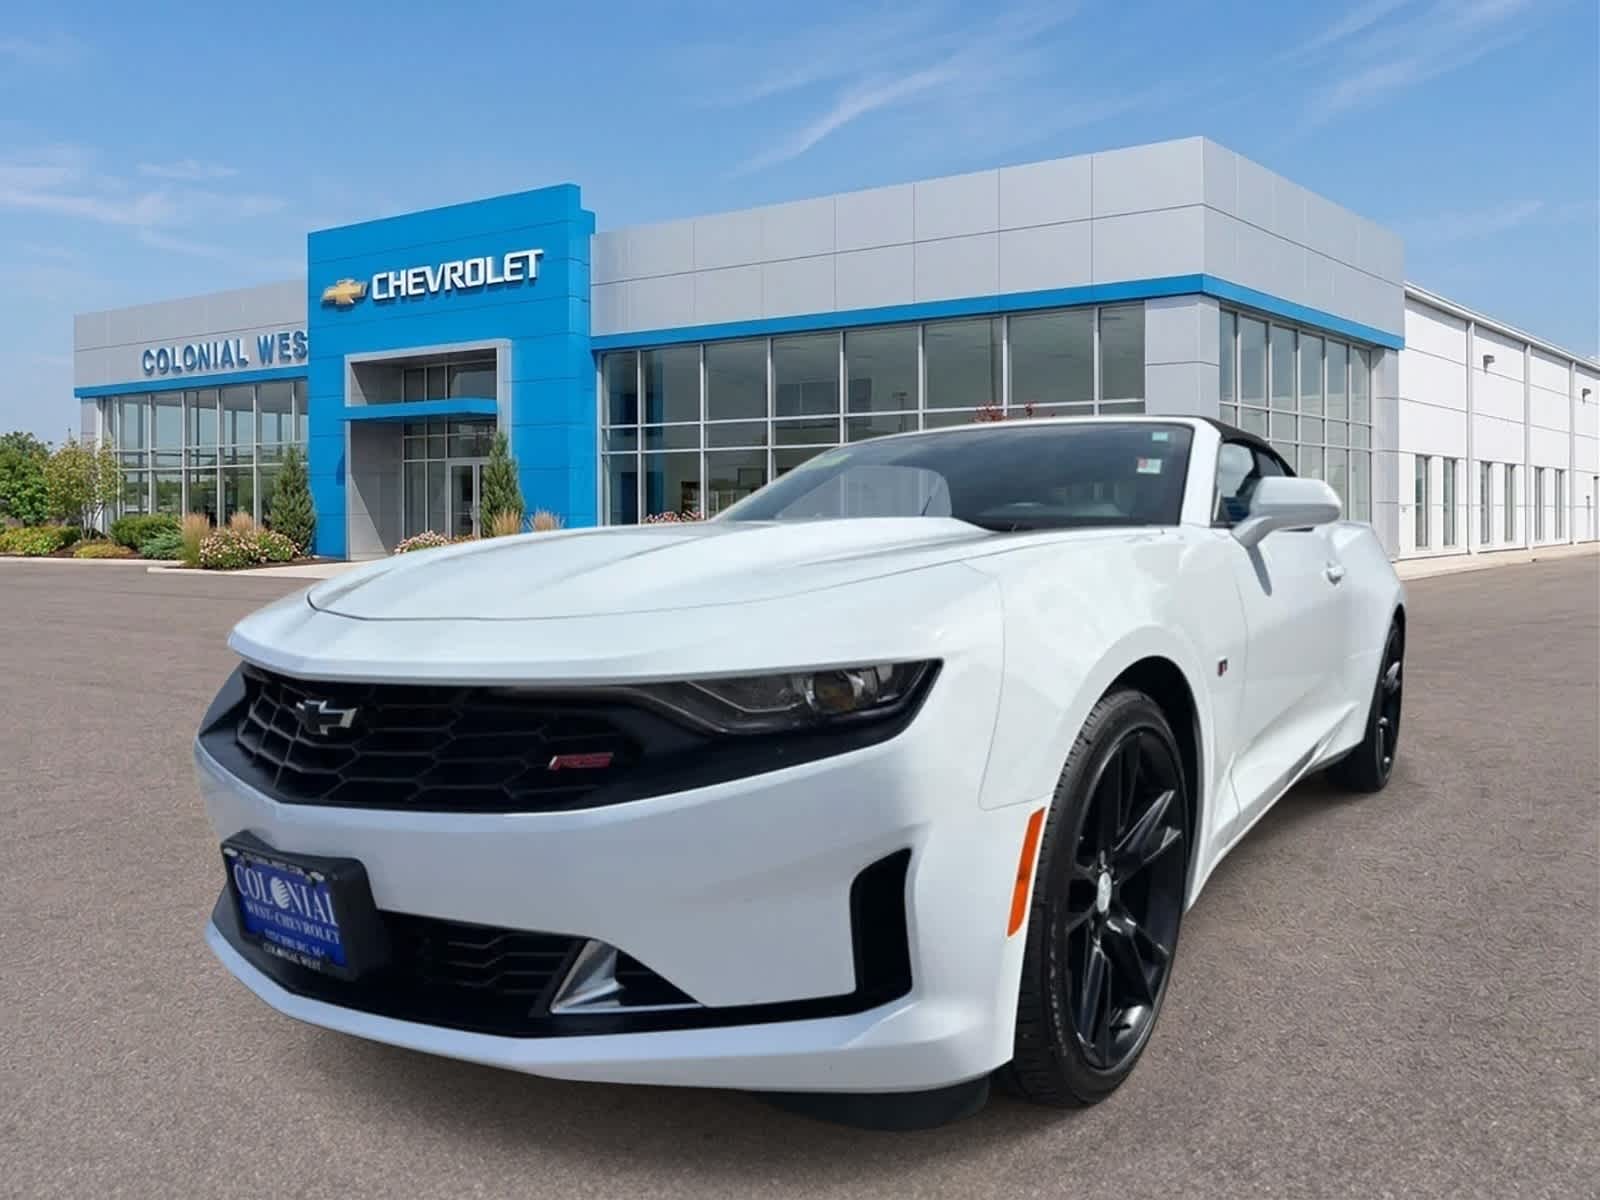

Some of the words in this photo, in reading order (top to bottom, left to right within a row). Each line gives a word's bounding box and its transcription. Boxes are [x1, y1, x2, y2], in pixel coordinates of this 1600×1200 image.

[372, 248, 544, 301] CHEVROLET
[142, 339, 249, 377] COLONIAL
[233, 863, 338, 927] COLONIAL
